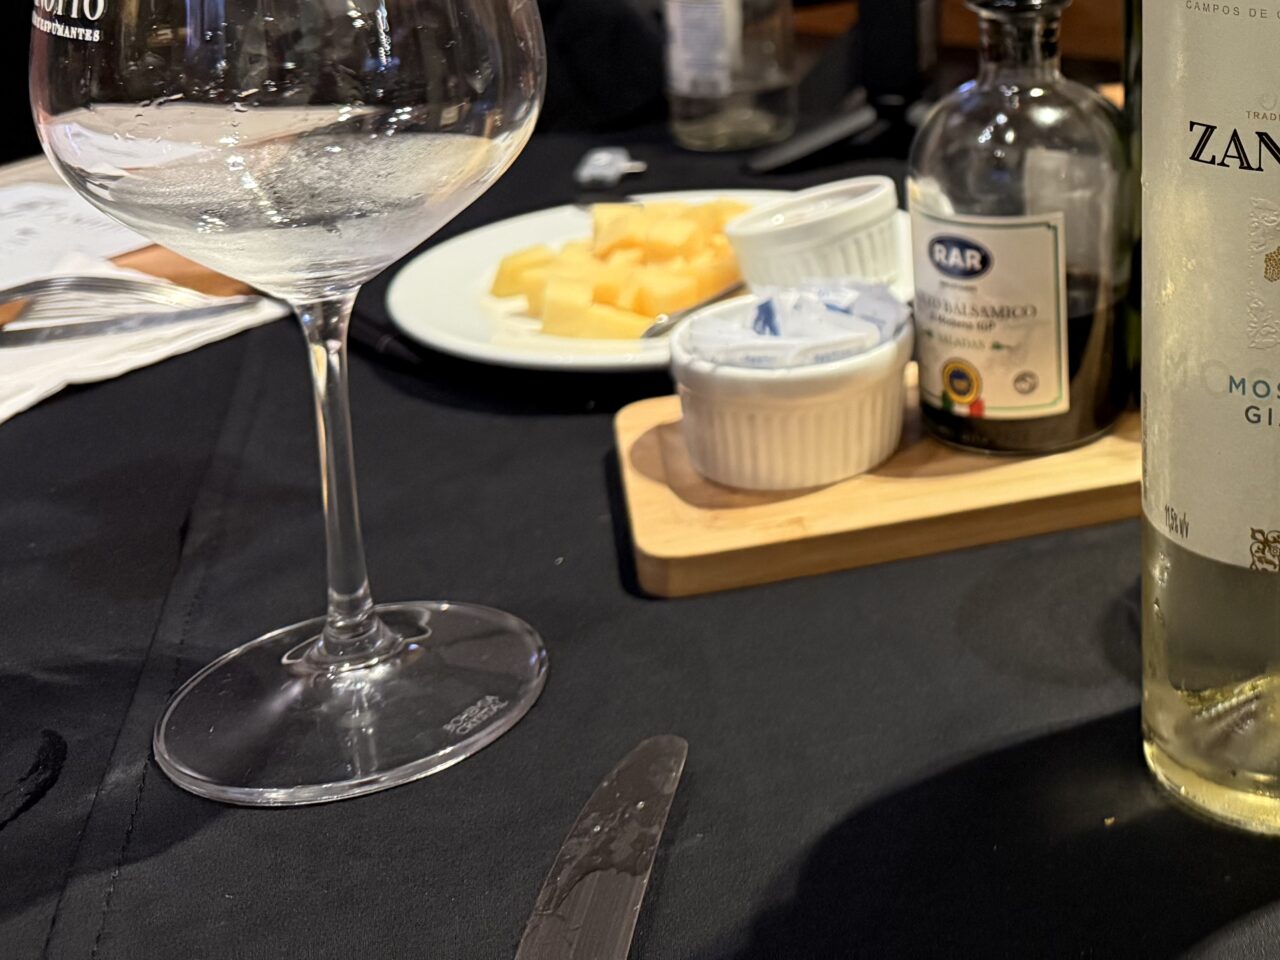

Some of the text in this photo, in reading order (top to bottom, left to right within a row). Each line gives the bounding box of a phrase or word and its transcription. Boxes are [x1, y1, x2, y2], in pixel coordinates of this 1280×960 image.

[1185, 0, 1241, 17] CAMPOS
[1248, 8, 1269, 19] DE
[933, 242, 983, 271] RAR
